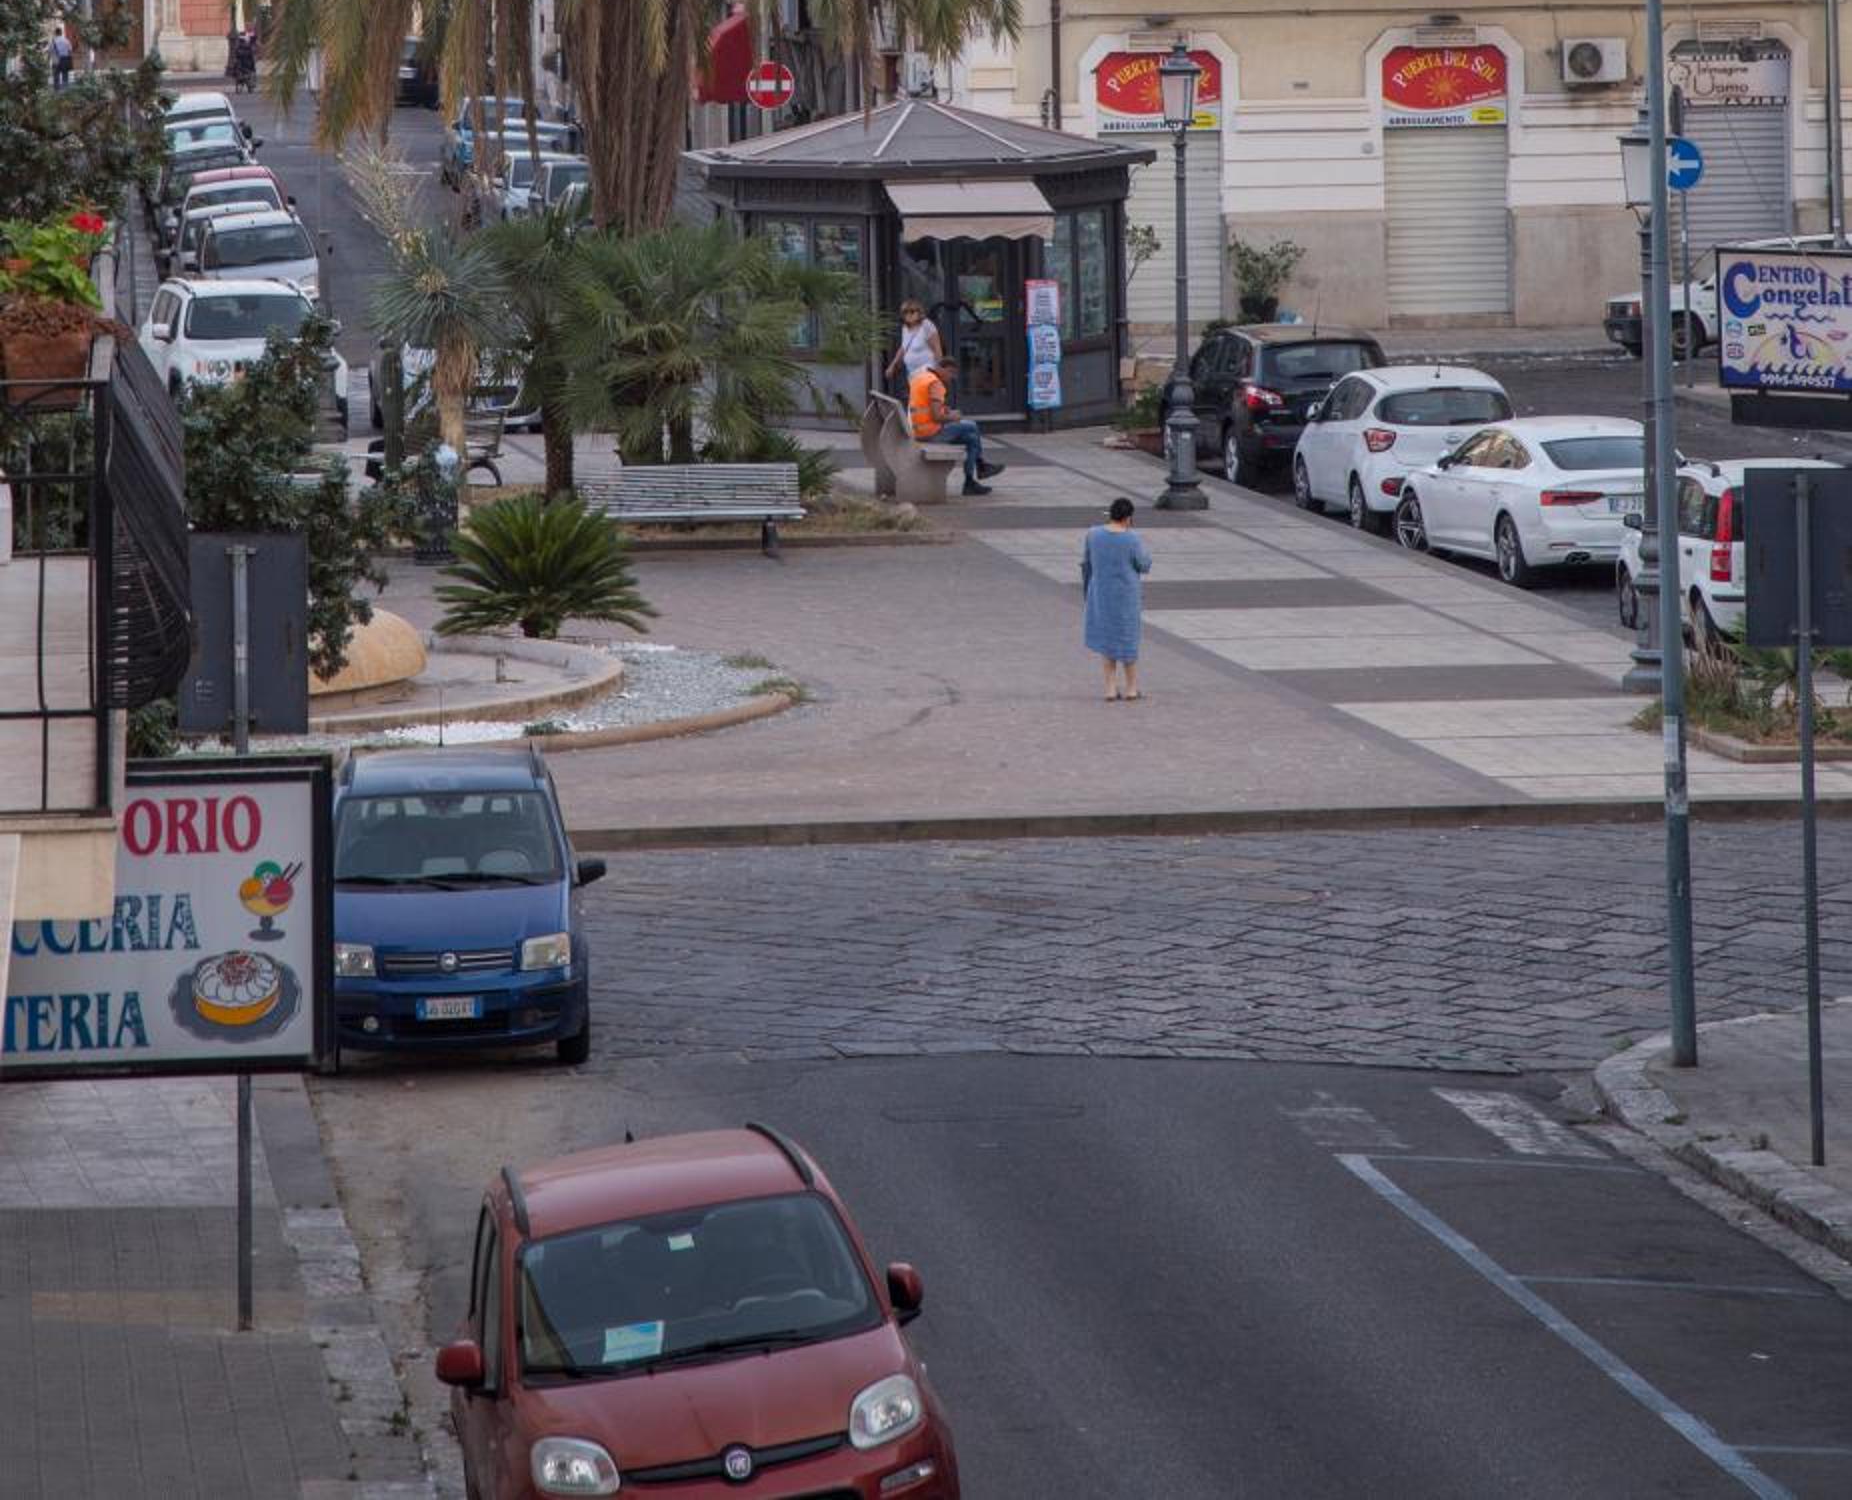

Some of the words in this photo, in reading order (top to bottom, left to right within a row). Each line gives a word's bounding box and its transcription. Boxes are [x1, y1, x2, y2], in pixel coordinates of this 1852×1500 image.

[1392, 51, 1442, 88] PUERTA
[1444, 49, 1468, 68] DEL
[124, 795, 262, 856] ORIO
